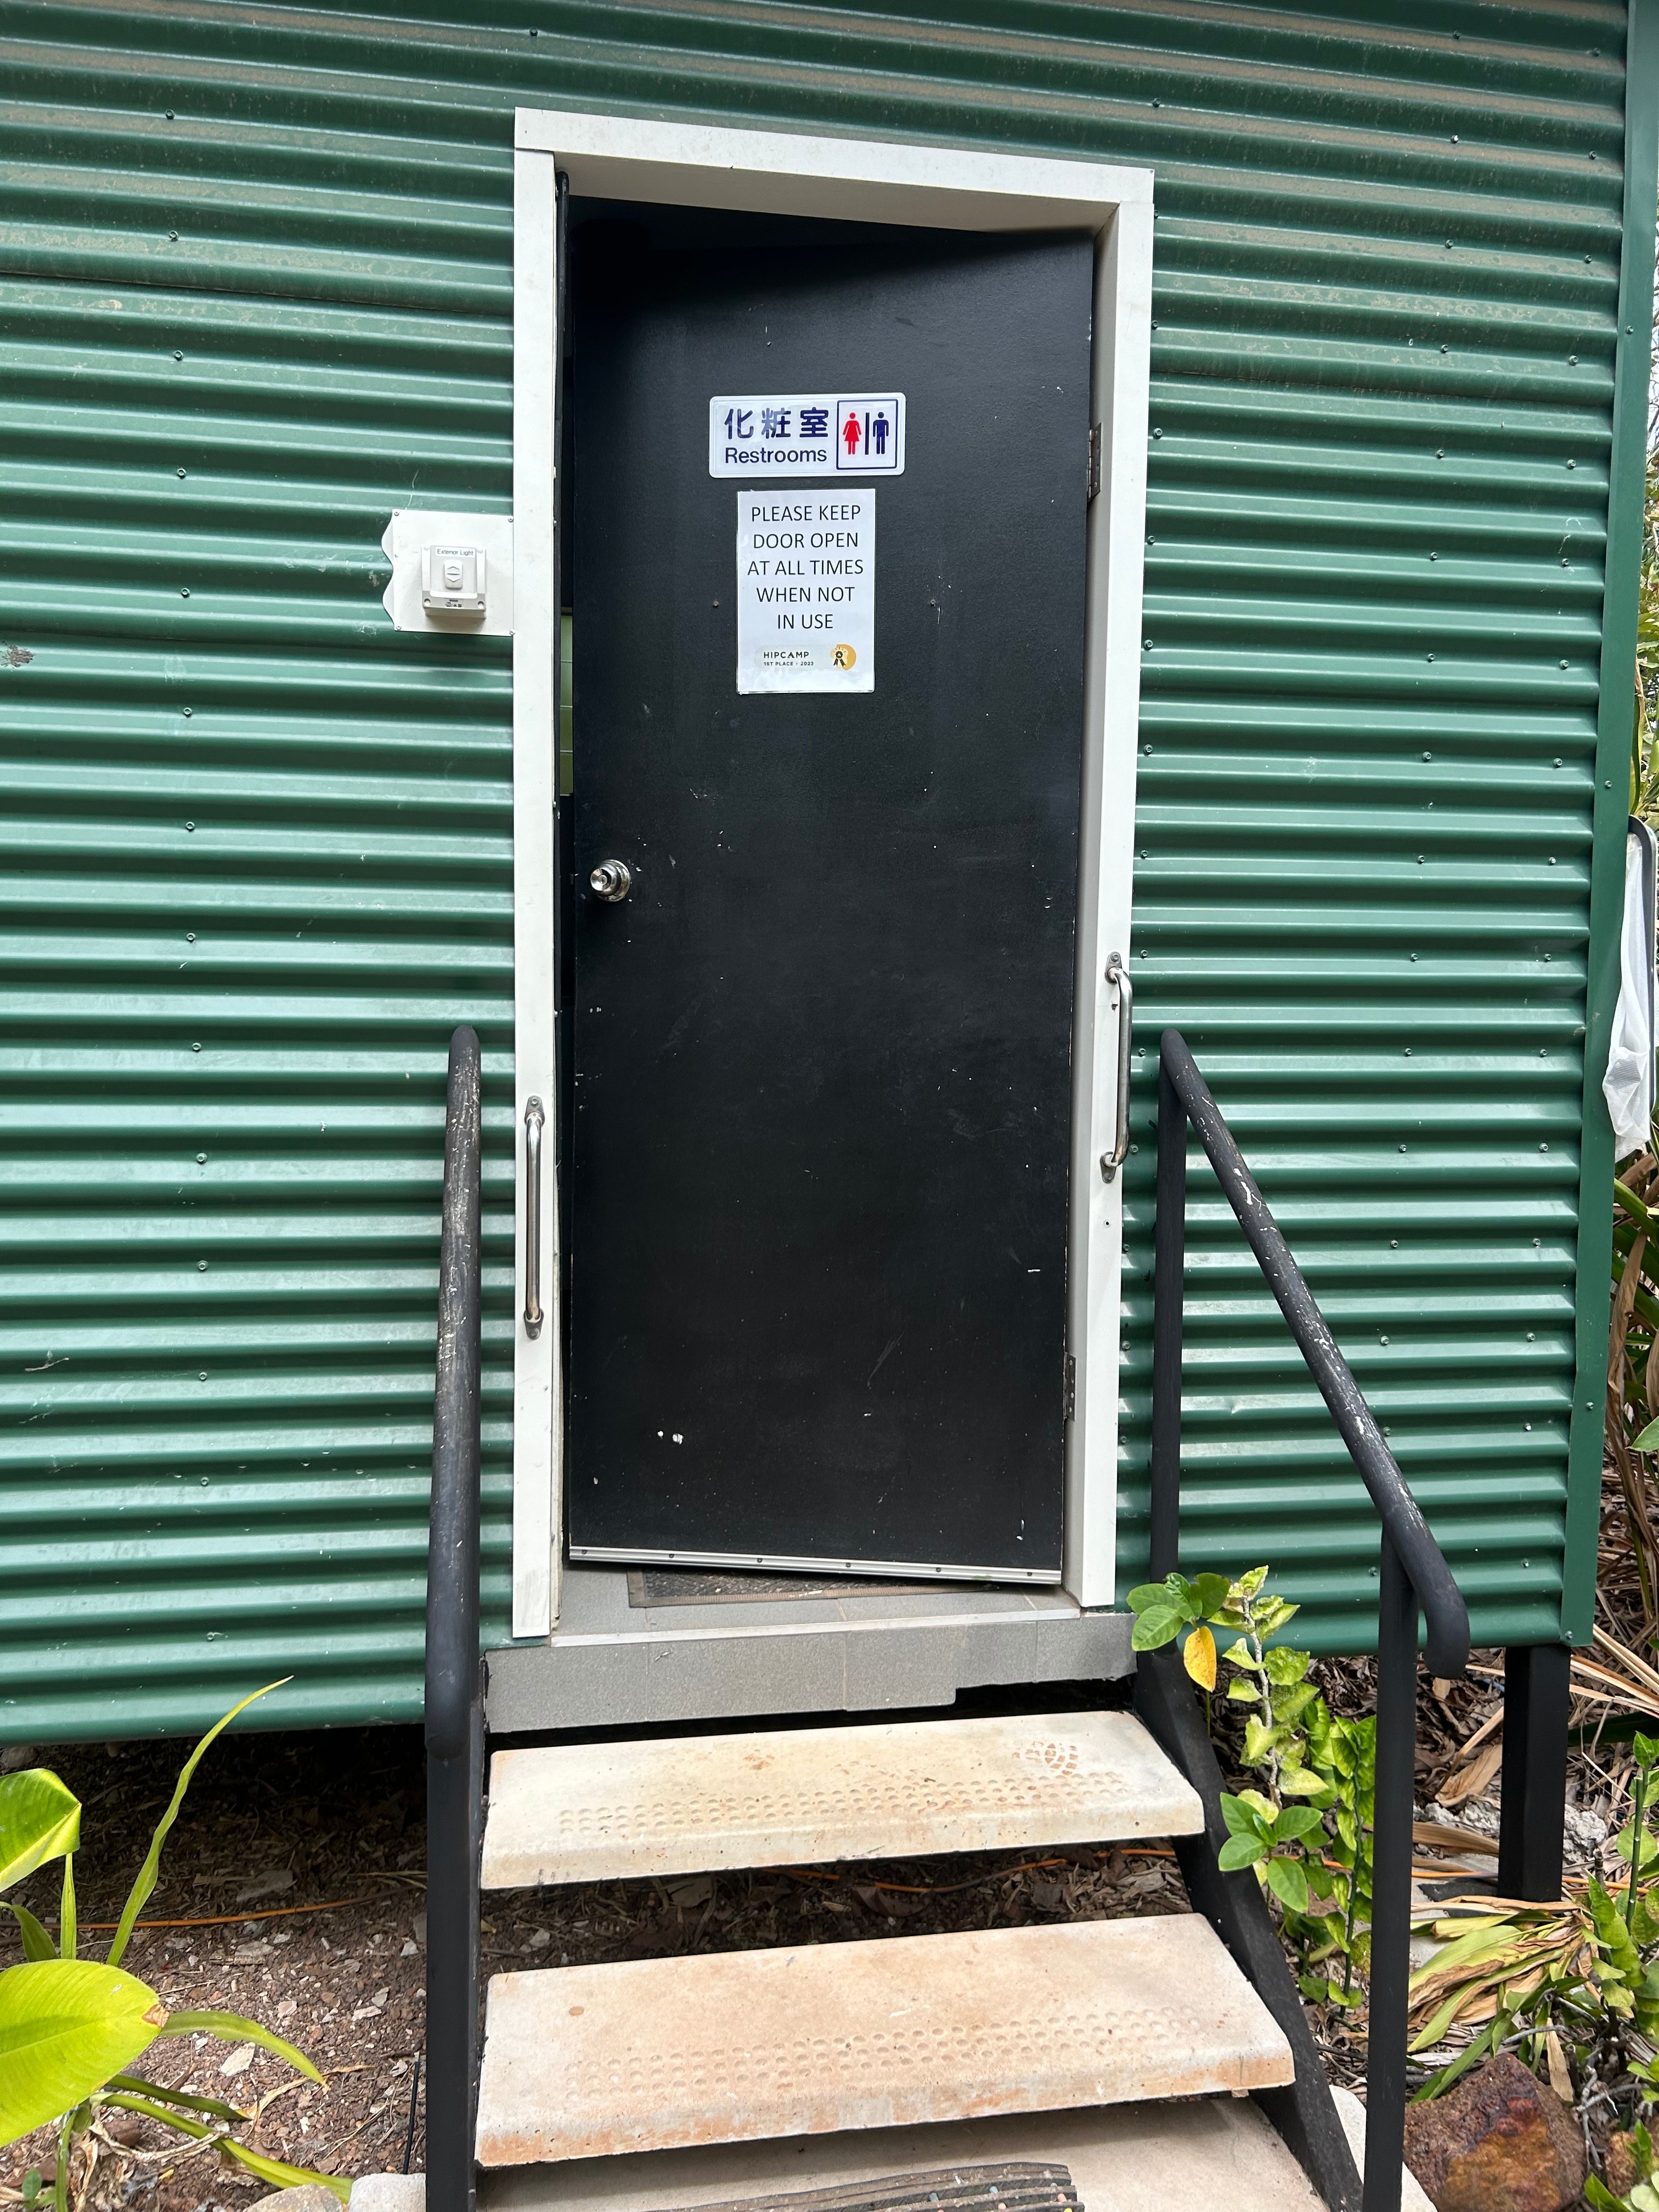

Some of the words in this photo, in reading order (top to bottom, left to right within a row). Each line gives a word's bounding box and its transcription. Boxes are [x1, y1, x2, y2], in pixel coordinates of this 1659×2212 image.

[724, 407, 829, 439] 化粧室
[725, 447, 827, 464] Restrooms
[751, 506, 813, 522] PLEASE
[820, 505, 861, 521] KEEP
[753, 533, 805, 549] DOOR
[810, 532, 859, 548] OPEN
[747, 561, 770, 575] AT
[775, 560, 805, 575] ALL
[810, 560, 864, 575] TIMES
[756, 586, 811, 603] WHEN
[817, 586, 855, 602] NOT
[777, 614, 794, 629] IN
[801, 613, 834, 629] USE
